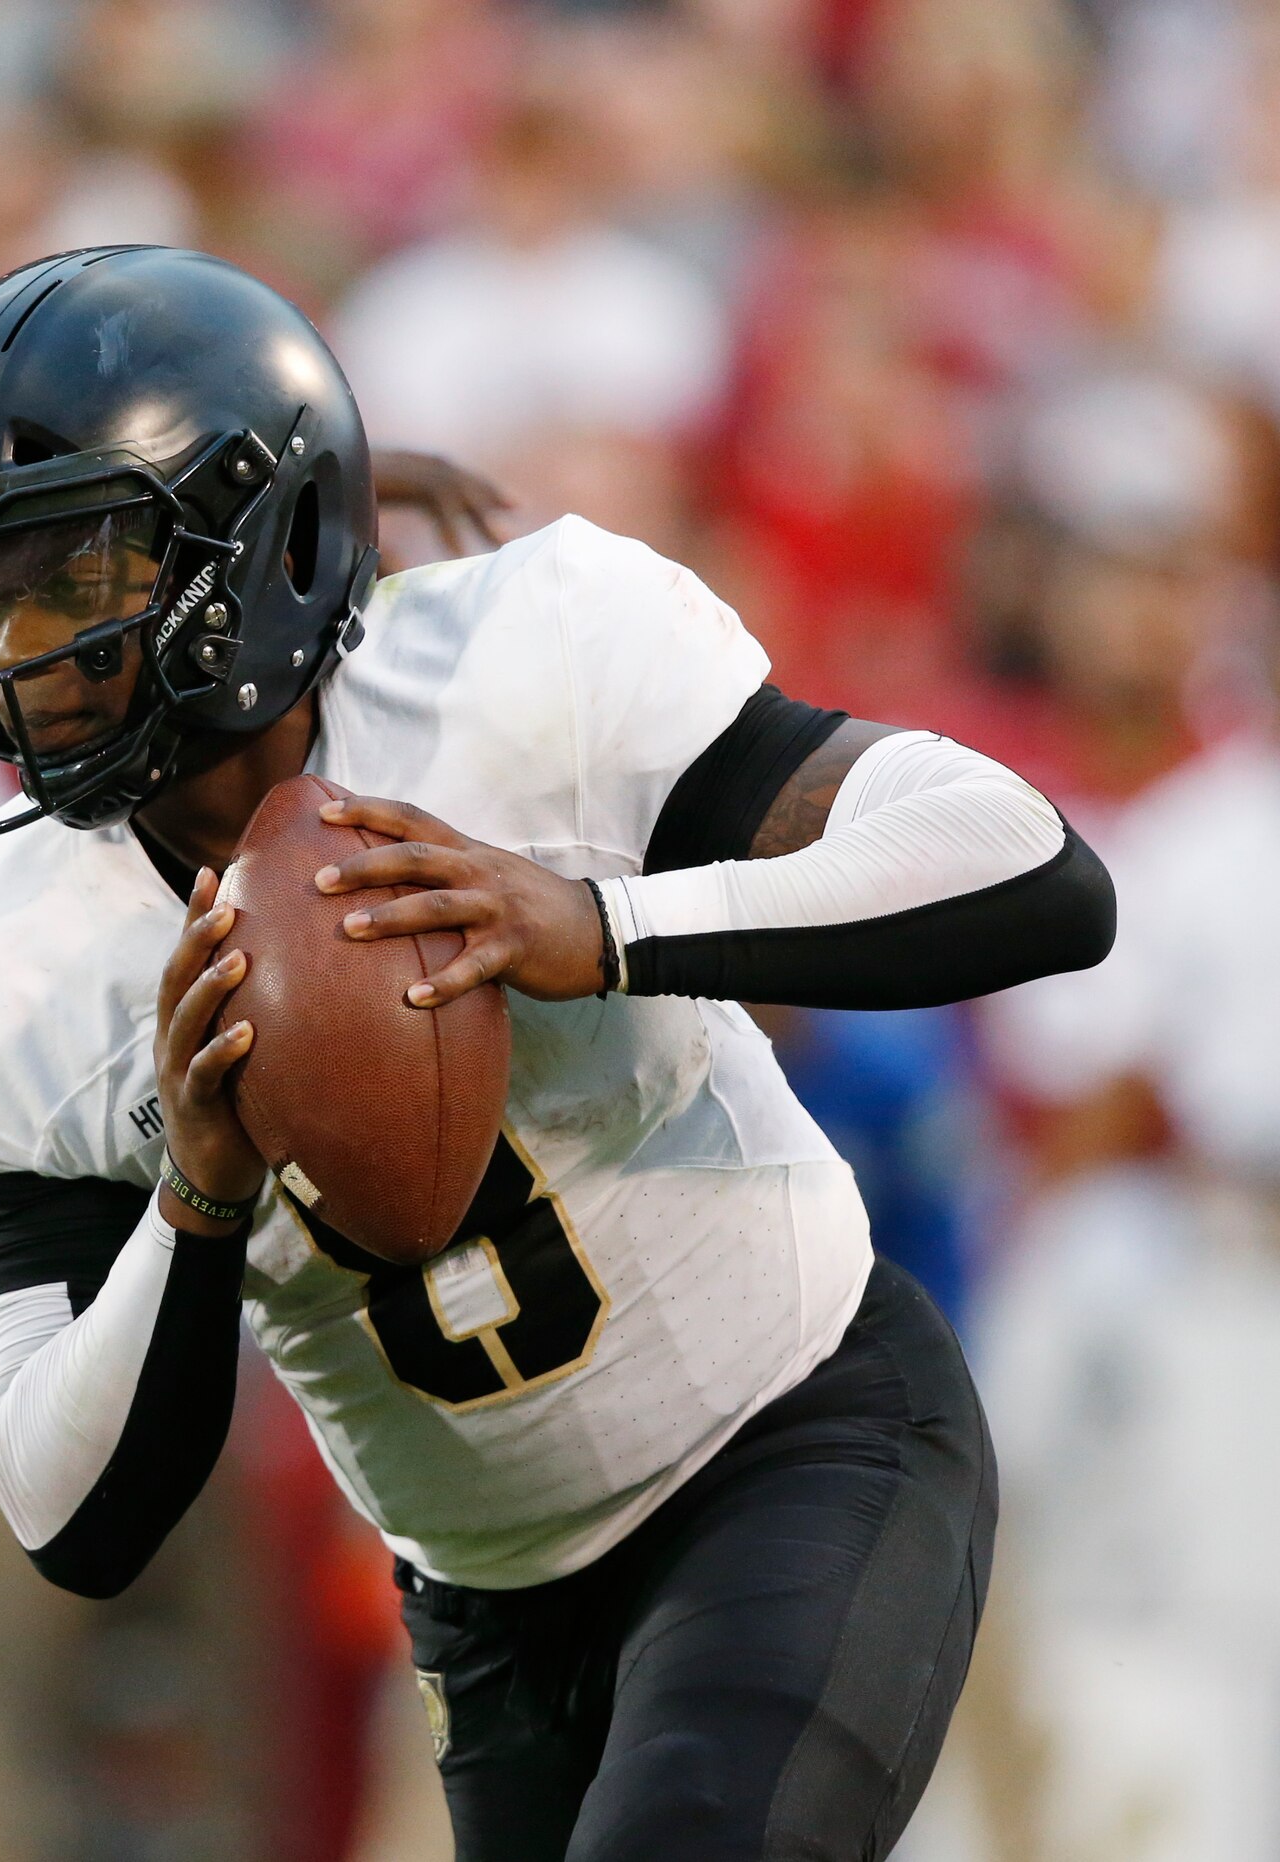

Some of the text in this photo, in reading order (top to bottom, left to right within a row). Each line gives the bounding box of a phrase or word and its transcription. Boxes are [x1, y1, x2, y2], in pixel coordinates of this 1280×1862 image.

[155, 609, 182, 656] ACK
[170, 1175, 237, 1218] NEVER DIE
